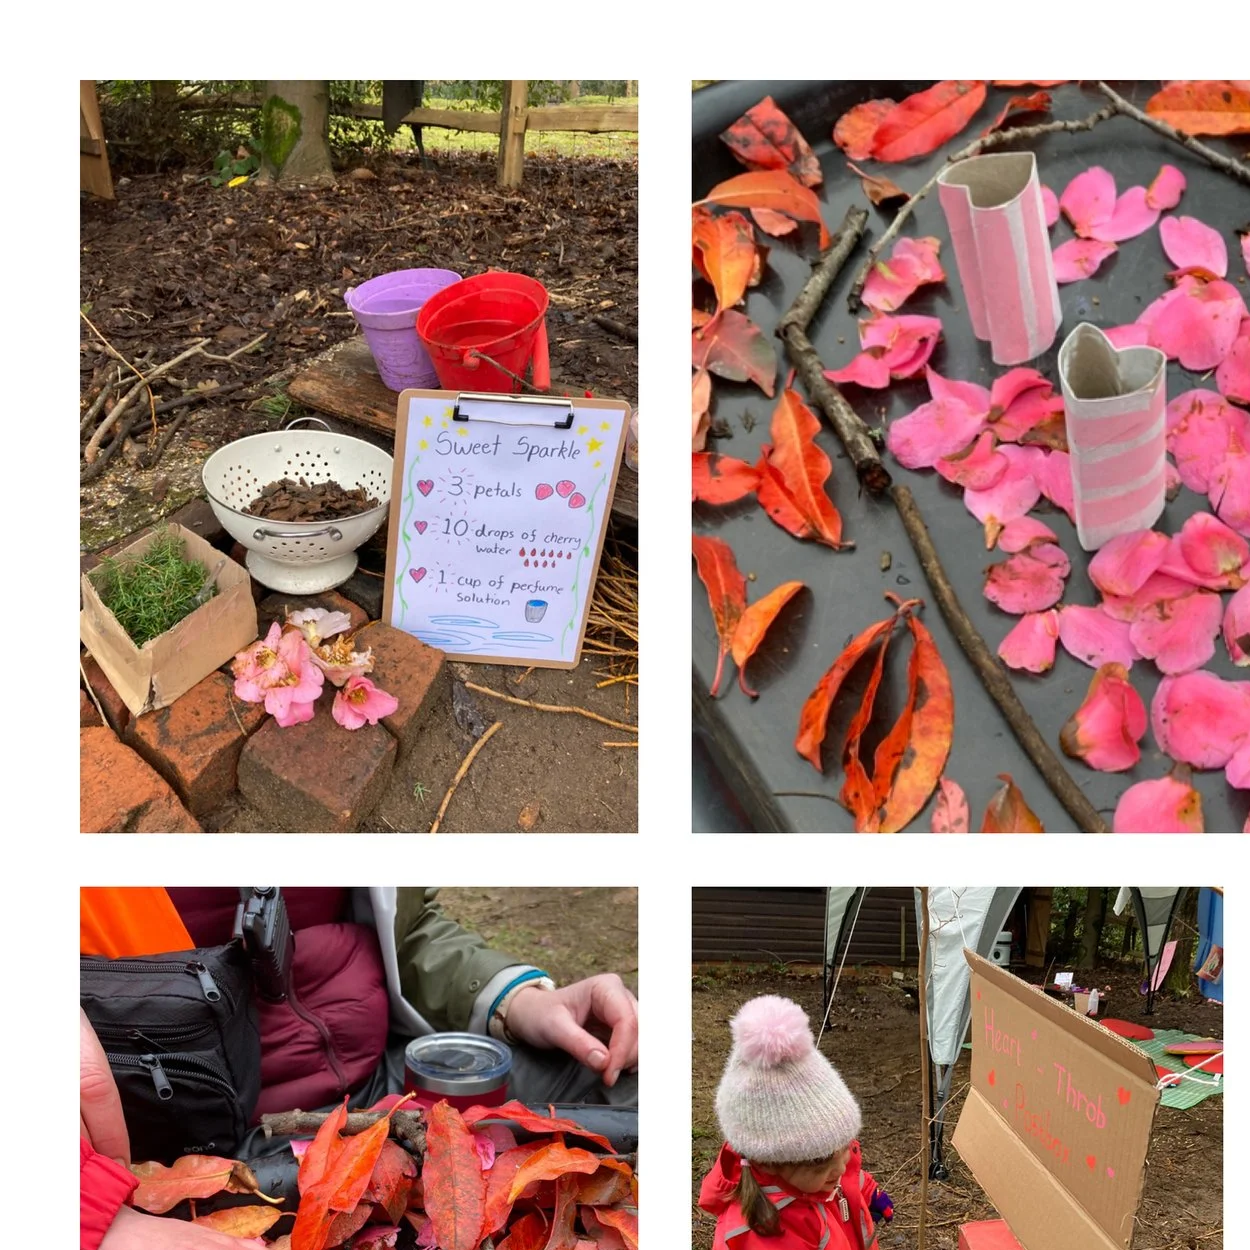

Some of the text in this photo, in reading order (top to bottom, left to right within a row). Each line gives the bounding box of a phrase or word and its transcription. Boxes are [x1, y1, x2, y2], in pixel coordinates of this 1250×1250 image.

[434, 431, 581, 462] Sweet Sparkle
[448, 475, 522, 499] 3 petals
[441, 518, 582, 550] 10 drops of cherry
[475, 545, 512, 555] water
[437, 569, 564, 595] 1 cup of perfume
[984, 1007, 1021, 1067] Heart
[1053, 1062, 1107, 1129] Throb
